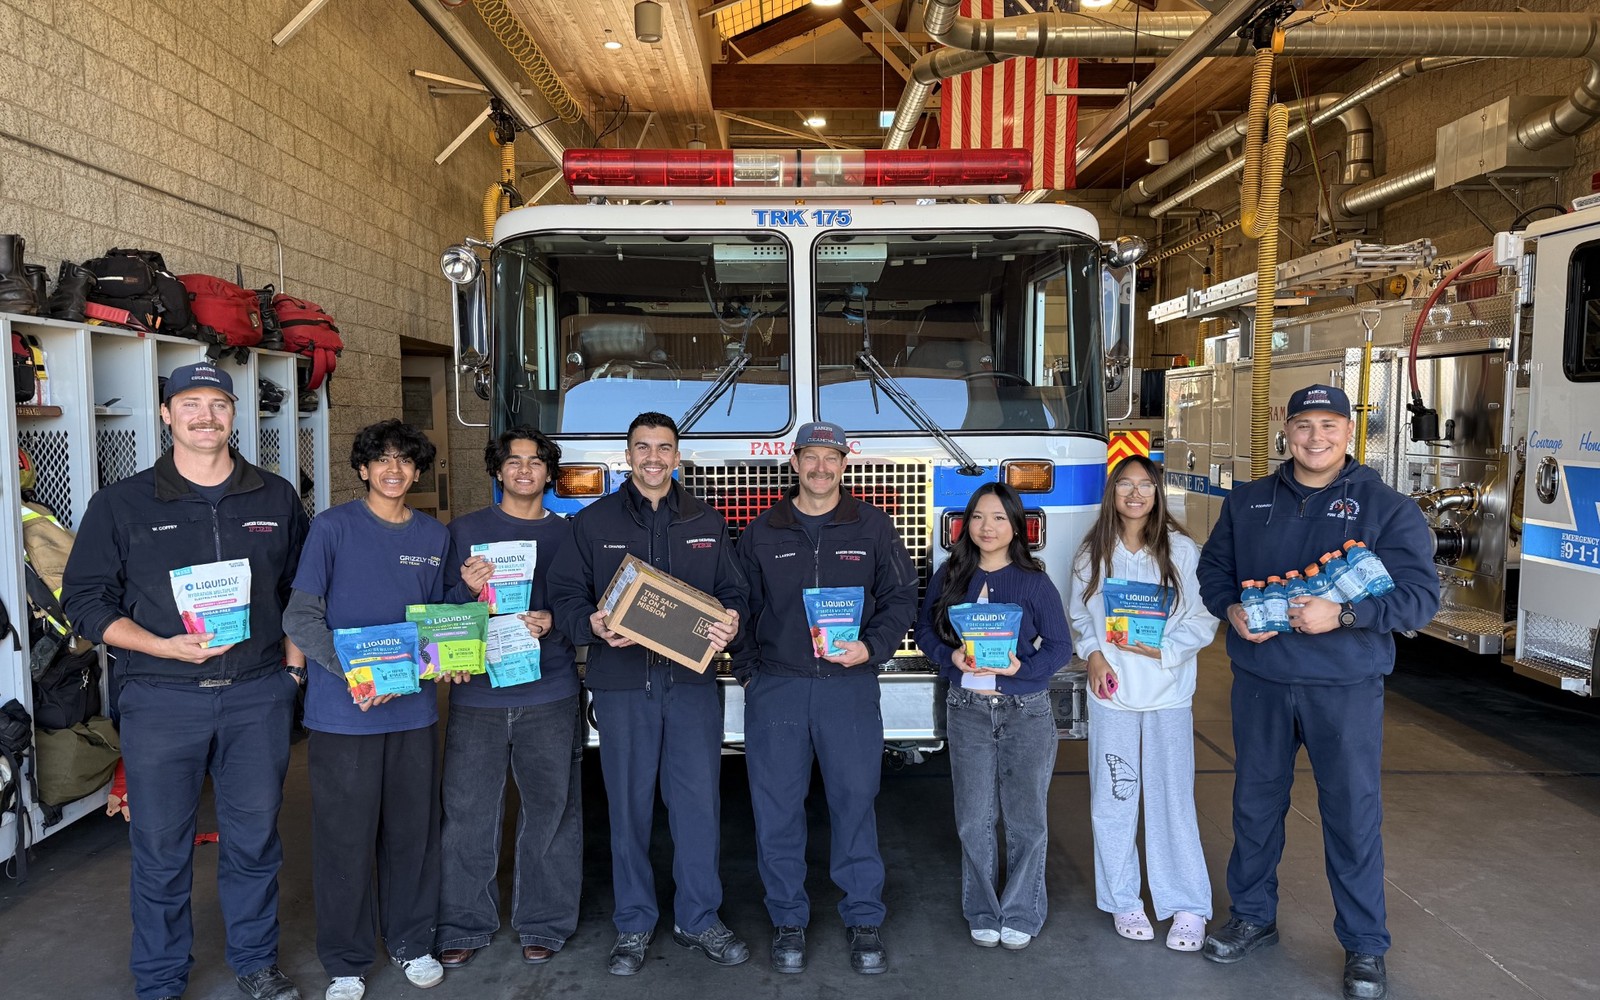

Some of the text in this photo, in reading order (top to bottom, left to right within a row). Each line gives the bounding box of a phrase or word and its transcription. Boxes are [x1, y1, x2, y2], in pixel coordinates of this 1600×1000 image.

[752, 209, 852, 227] TRK 175
[1529, 430, 1563, 454] Courage
[1171, 474, 1204, 492] ENGINE 175
[1562, 533, 1600, 545] EMERGENCY
[491, 555, 517, 563] LIQUID
[1565, 542, 1599, 564] 9-1-1
[400, 555, 427, 563] GRIZZLY
[428, 559, 440, 567] TECH
[195, 576, 239, 590] LIQUID I.V.
[644, 589, 678, 610] THIS SALT
[649, 599, 660, 608] ON
[1126, 594, 1150, 602] LIQUID
[637, 600, 666, 619] MISSION
[434, 616, 461, 624] LIQUID
[363, 639, 390, 649] LIQUID
